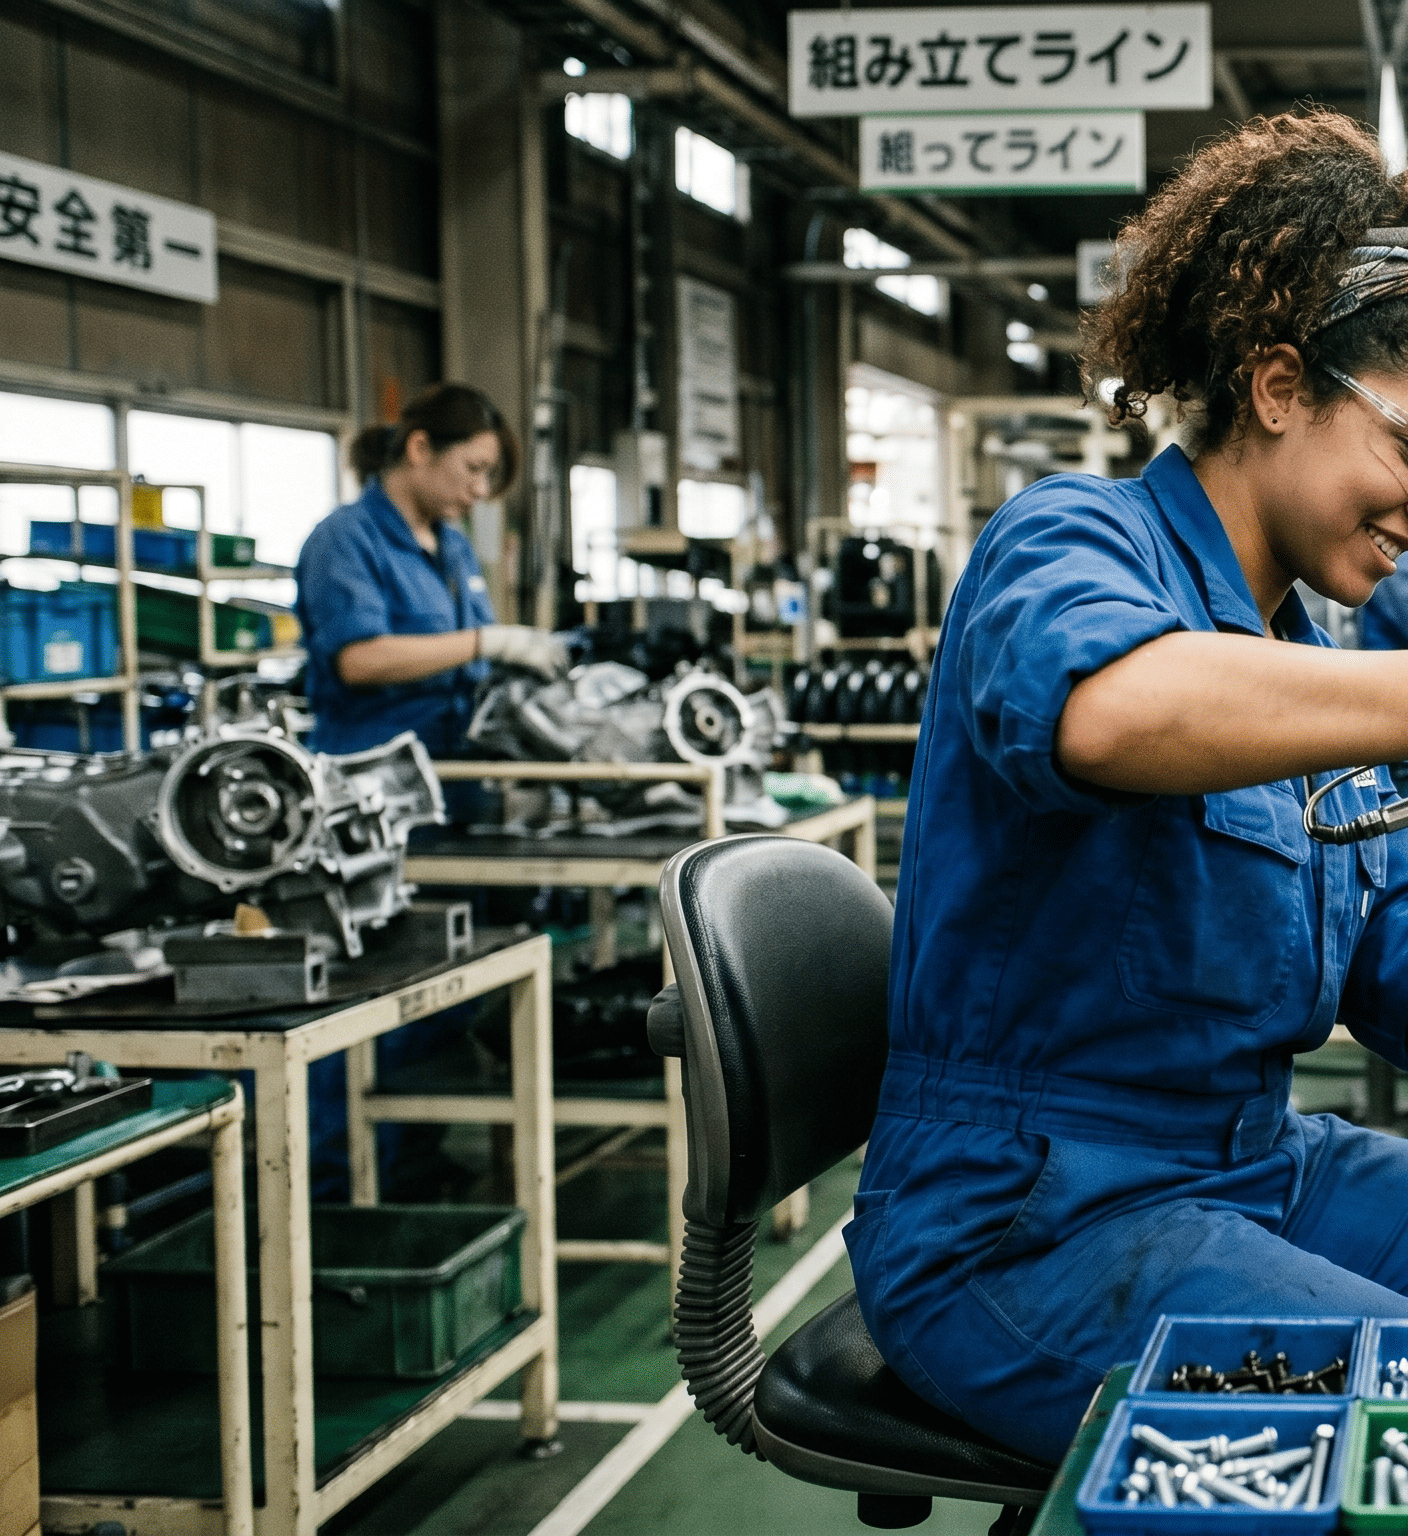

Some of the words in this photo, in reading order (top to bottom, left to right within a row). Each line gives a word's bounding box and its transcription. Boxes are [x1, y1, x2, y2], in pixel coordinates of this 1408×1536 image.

[808, 30, 1190, 91] 組み立てライン
[0, 173, 201, 270] 安全第一
